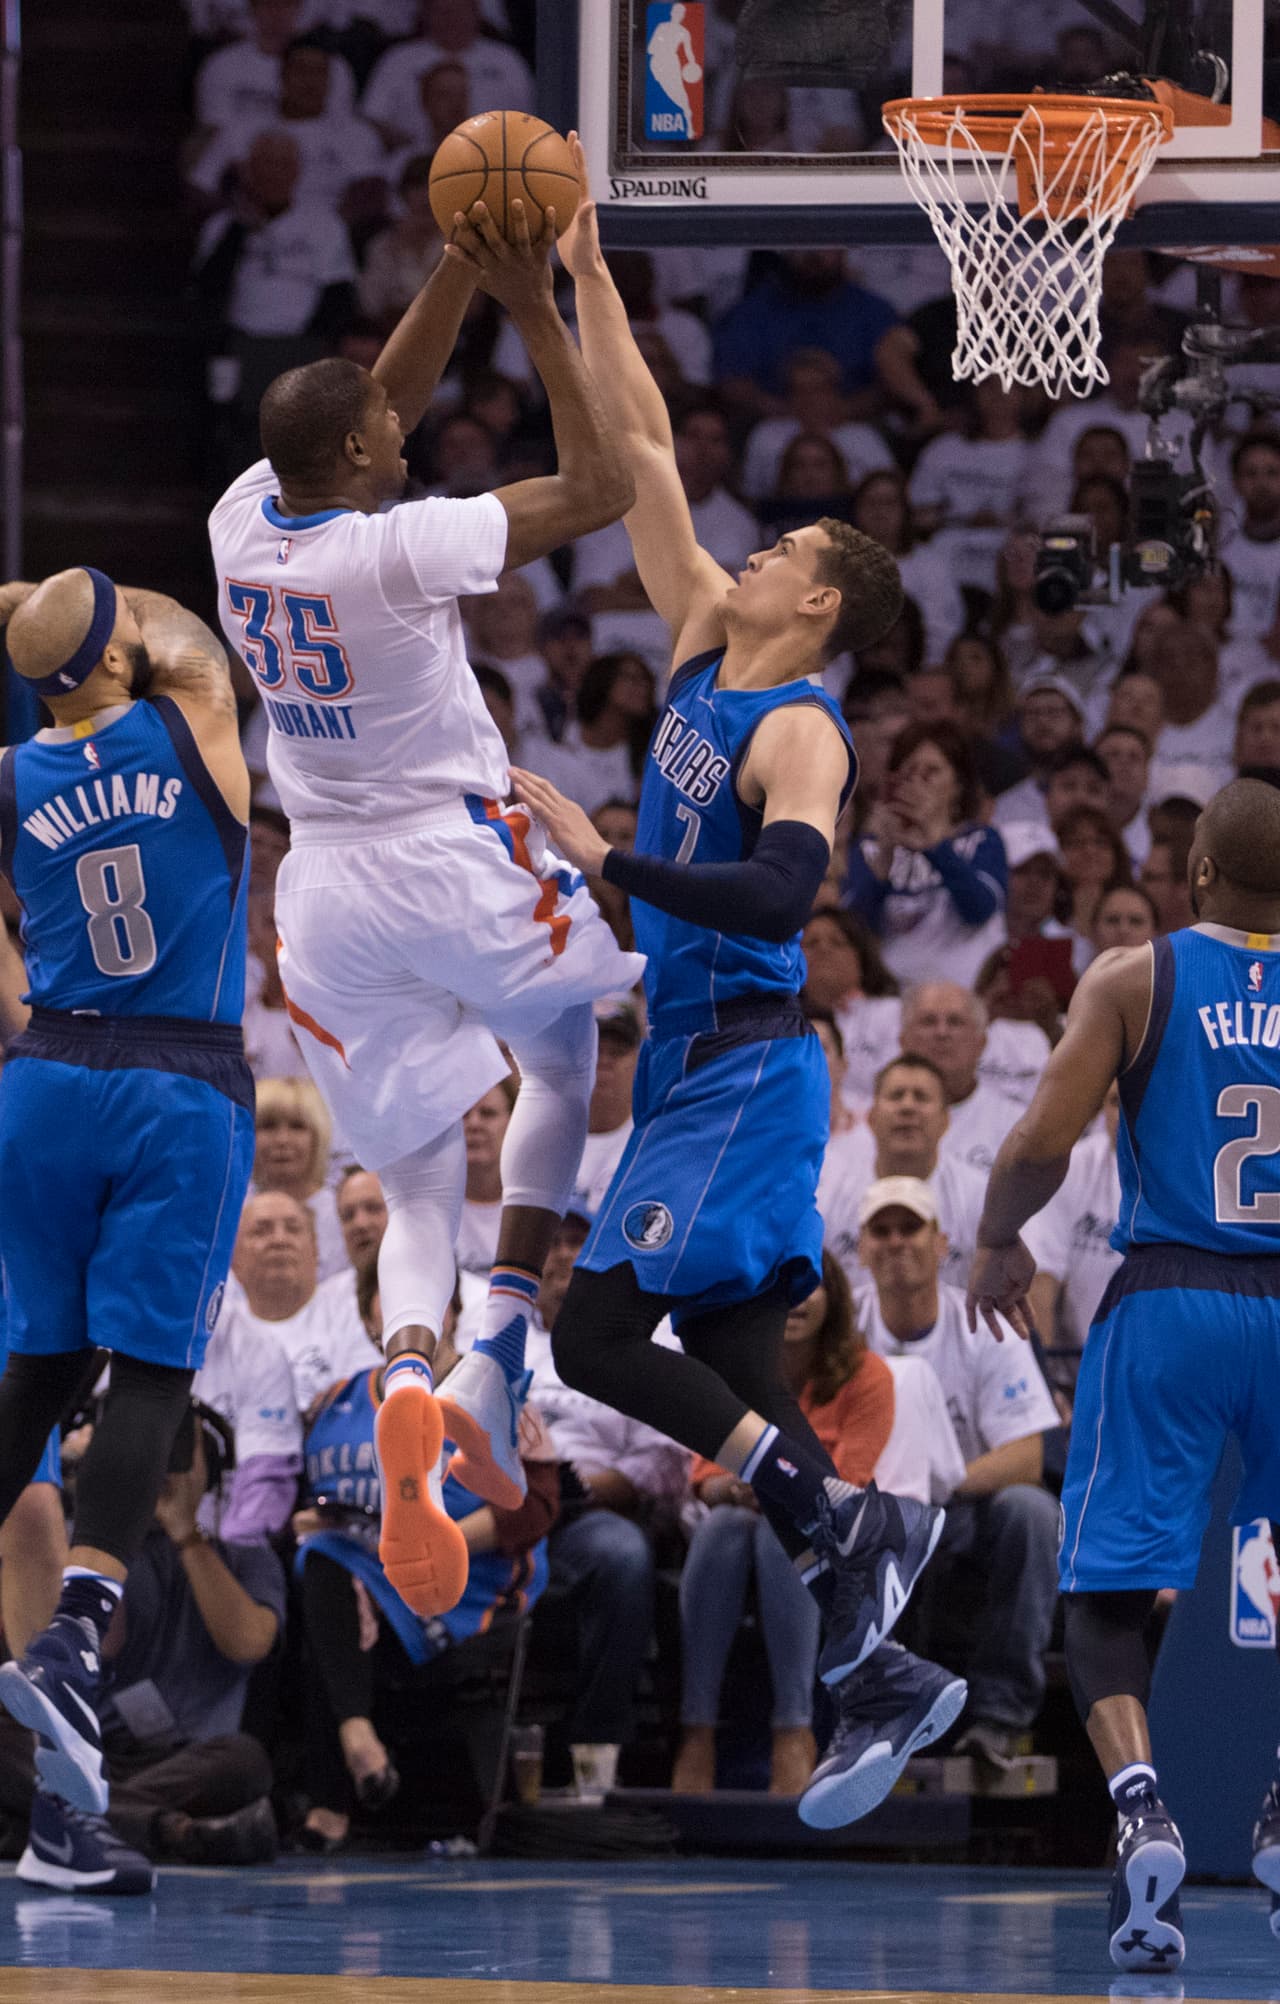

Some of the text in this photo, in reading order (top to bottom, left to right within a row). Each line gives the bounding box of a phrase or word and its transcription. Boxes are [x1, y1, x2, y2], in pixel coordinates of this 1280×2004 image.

[651, 112, 685, 132] NBA
[609, 176, 708, 200] SPALDING
[224, 576, 356, 701] 35
[23, 772, 183, 850] WILLIAMS
[675, 802, 701, 866] 7
[75, 843, 157, 977] 8
[1213, 1083, 1280, 1224] 2
[1239, 1617, 1270, 1636] NBA
